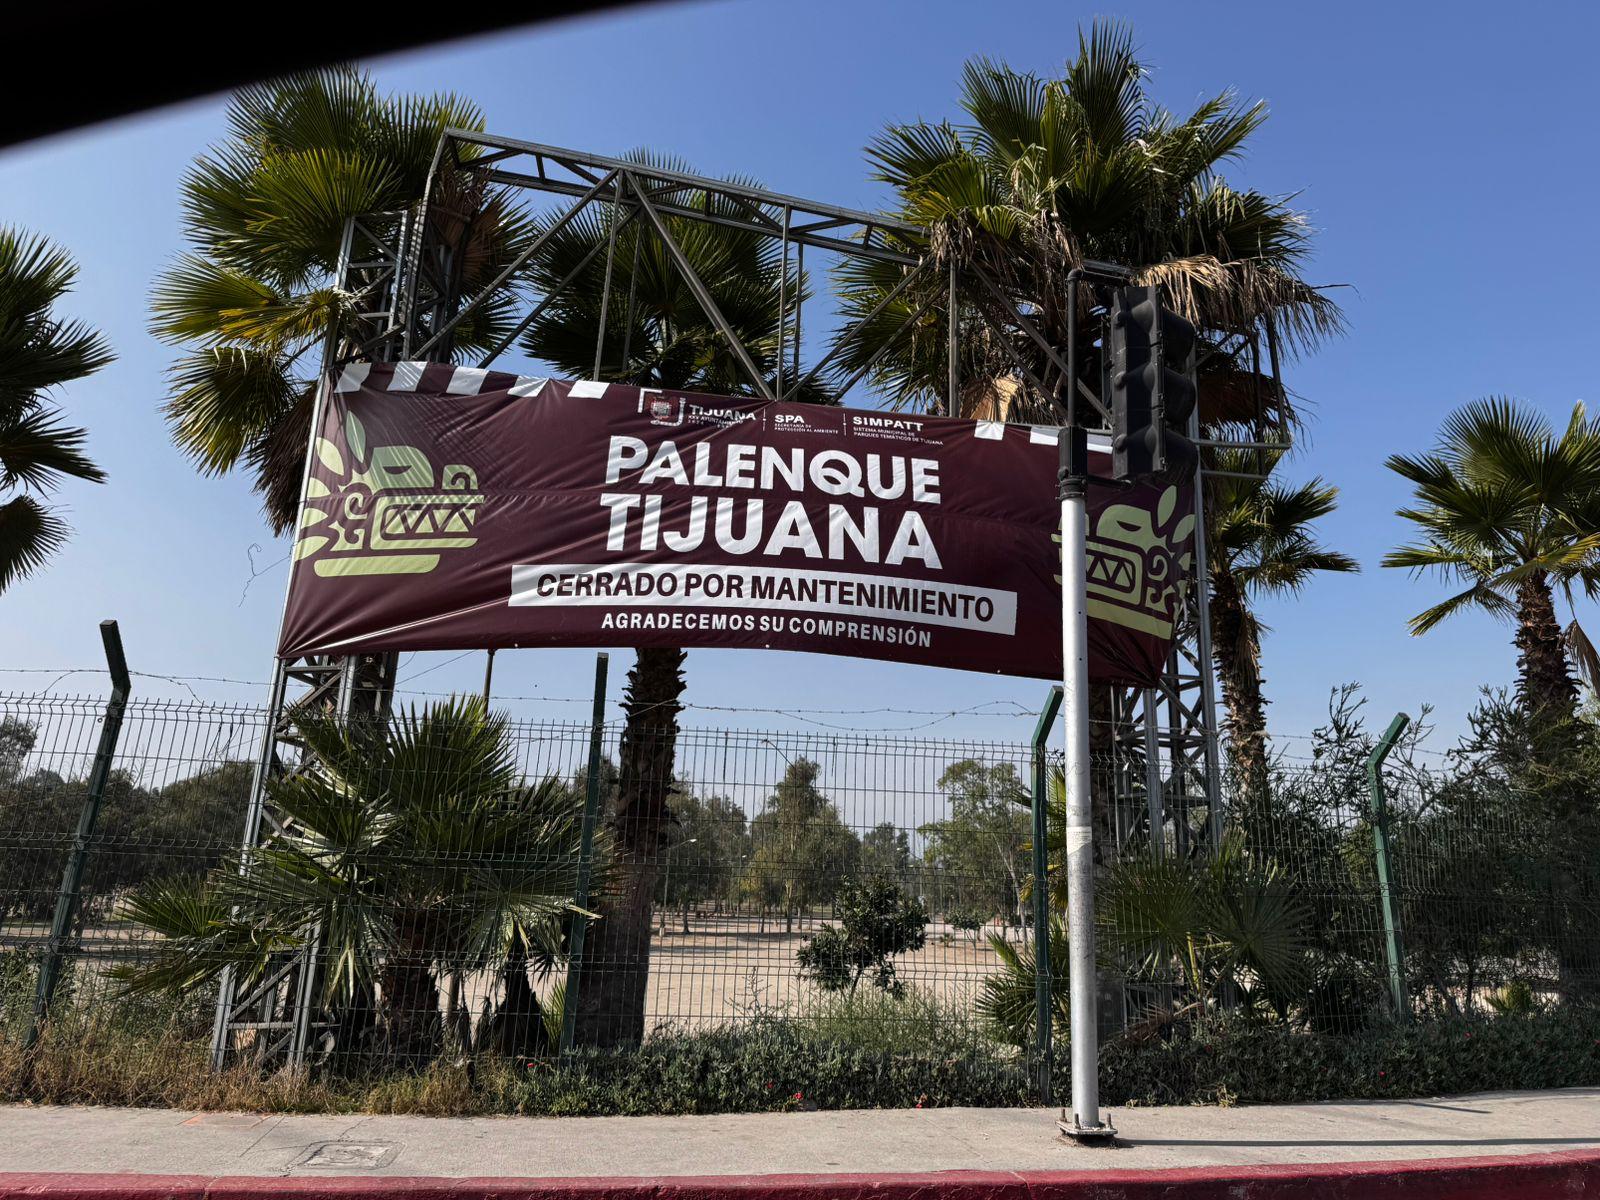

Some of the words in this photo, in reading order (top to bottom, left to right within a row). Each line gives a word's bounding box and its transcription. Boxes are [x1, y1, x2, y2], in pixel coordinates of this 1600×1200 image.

[689, 404, 756, 421] TIJUANA
[774, 414, 805, 423] SPA
[853, 416, 924, 431] SIMPATT
[605, 435, 941, 505] PALENQUE
[600, 493, 943, 570] TIJUANA
[537, 572, 678, 597] CERRADO
[684, 575, 743, 599] POR
[750, 576, 994, 622] MANTENIMIENTO
[601, 612, 755, 630] AGRADECEMOS
[759, 615, 784, 631] SU
[789, 617, 931, 648] COMPRENSIÓN
